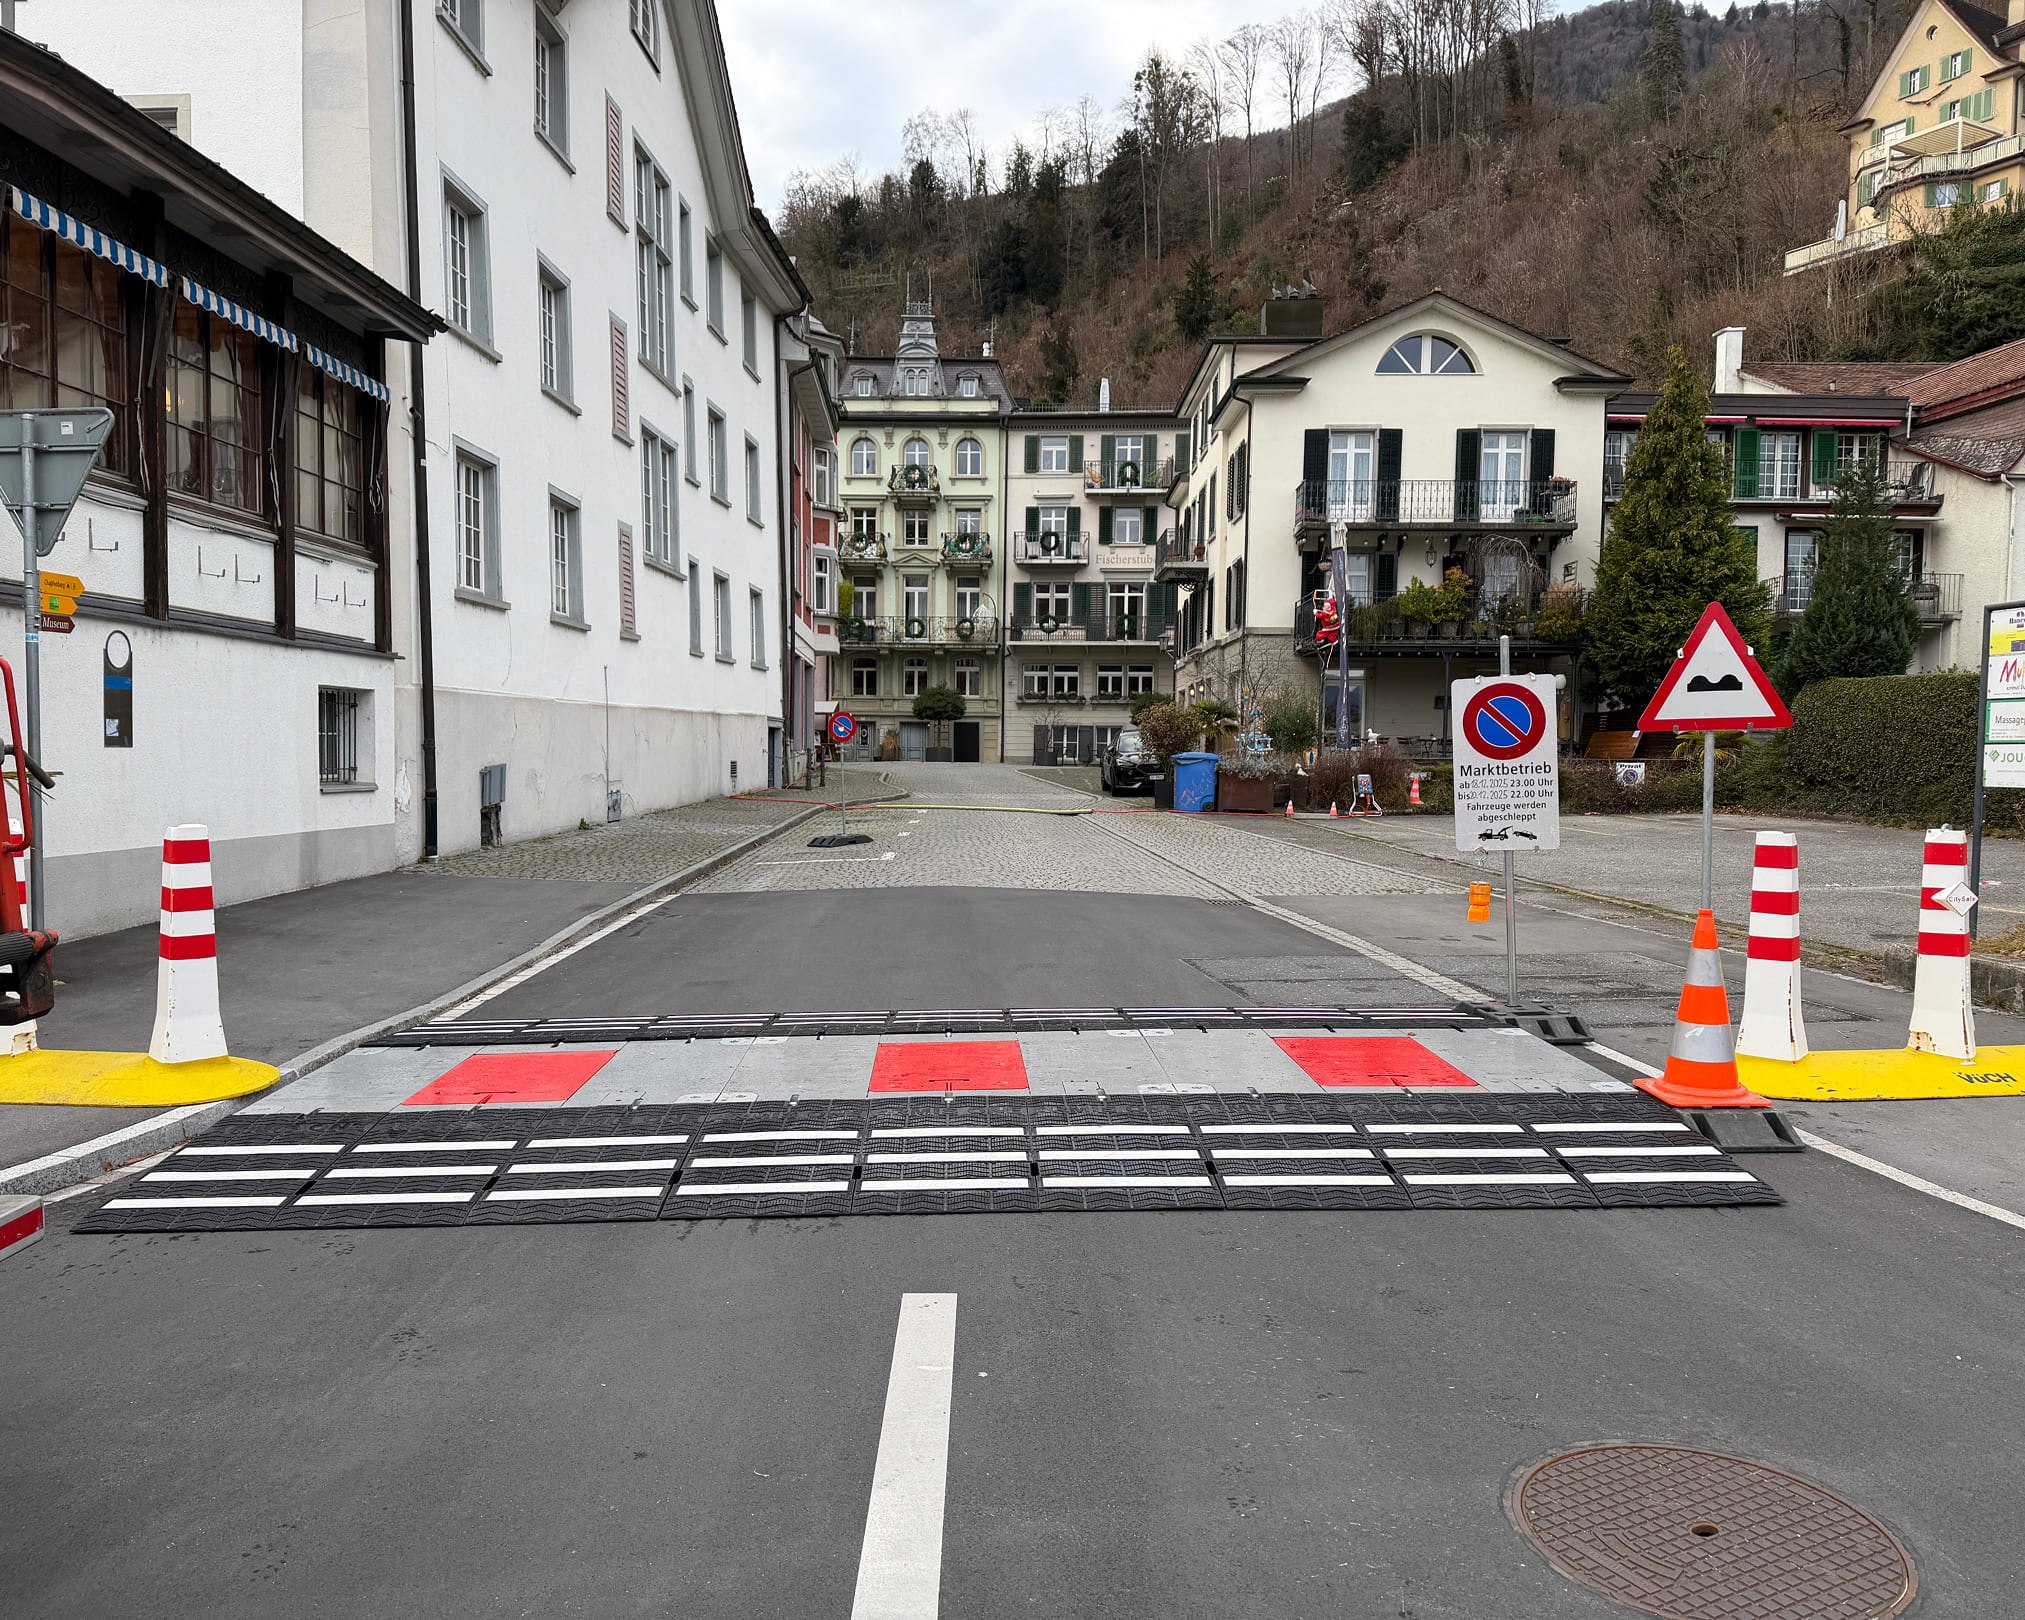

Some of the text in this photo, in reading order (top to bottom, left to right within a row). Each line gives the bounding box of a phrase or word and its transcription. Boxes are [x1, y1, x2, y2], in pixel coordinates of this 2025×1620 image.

[42, 616, 70, 630] Museum
[1995, 715, 2025, 726] Massage
[2000, 752, 2025, 763] JOU
[1460, 761, 1552, 777] Marktbetrieb
[1459, 781, 1470, 789] ab
[1510, 778, 1535, 788] 23.00
[1537, 777, 1553, 787] Uhr
[1458, 792, 1470, 800] bis
[1510, 790, 1535, 799] 22.00
[1538, 789, 1553, 798] Uhr
[1467, 801, 1547, 812] Fahrzeuge werden
[1477, 812, 1537, 823] abgeschleppt
